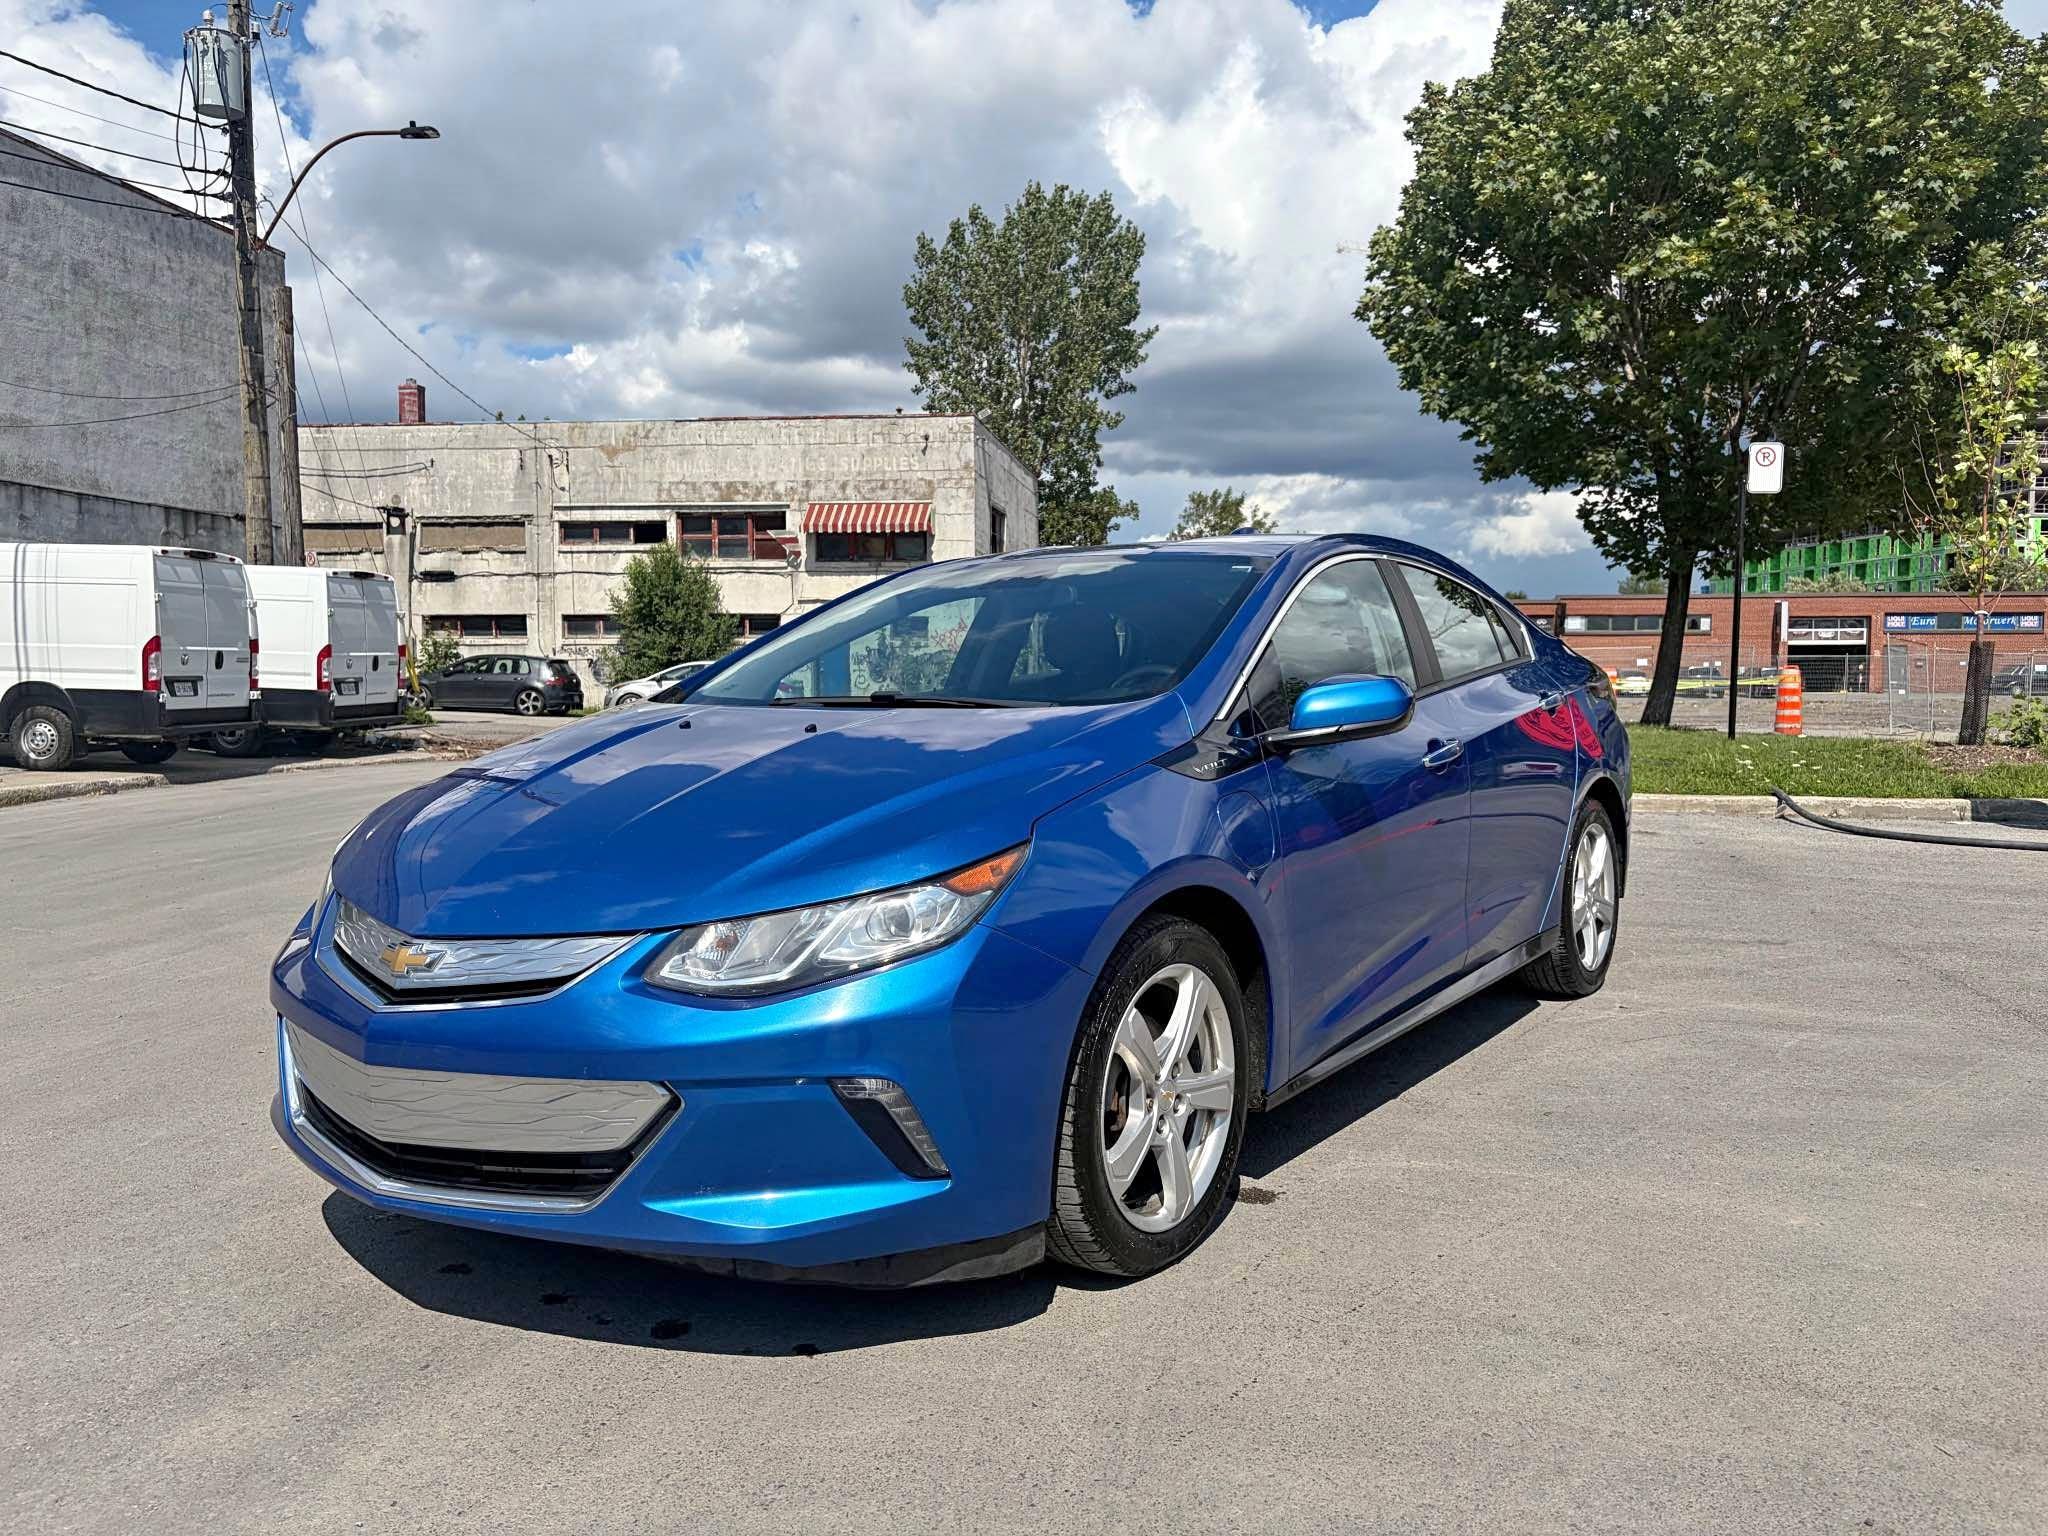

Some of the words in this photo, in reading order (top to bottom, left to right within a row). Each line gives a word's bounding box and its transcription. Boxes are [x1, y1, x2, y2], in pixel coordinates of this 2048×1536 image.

[840, 455, 920, 472] SUPPLIES
[1911, 616, 1936, 625] Euro
[1964, 616, 2016, 625] Moorwerk
